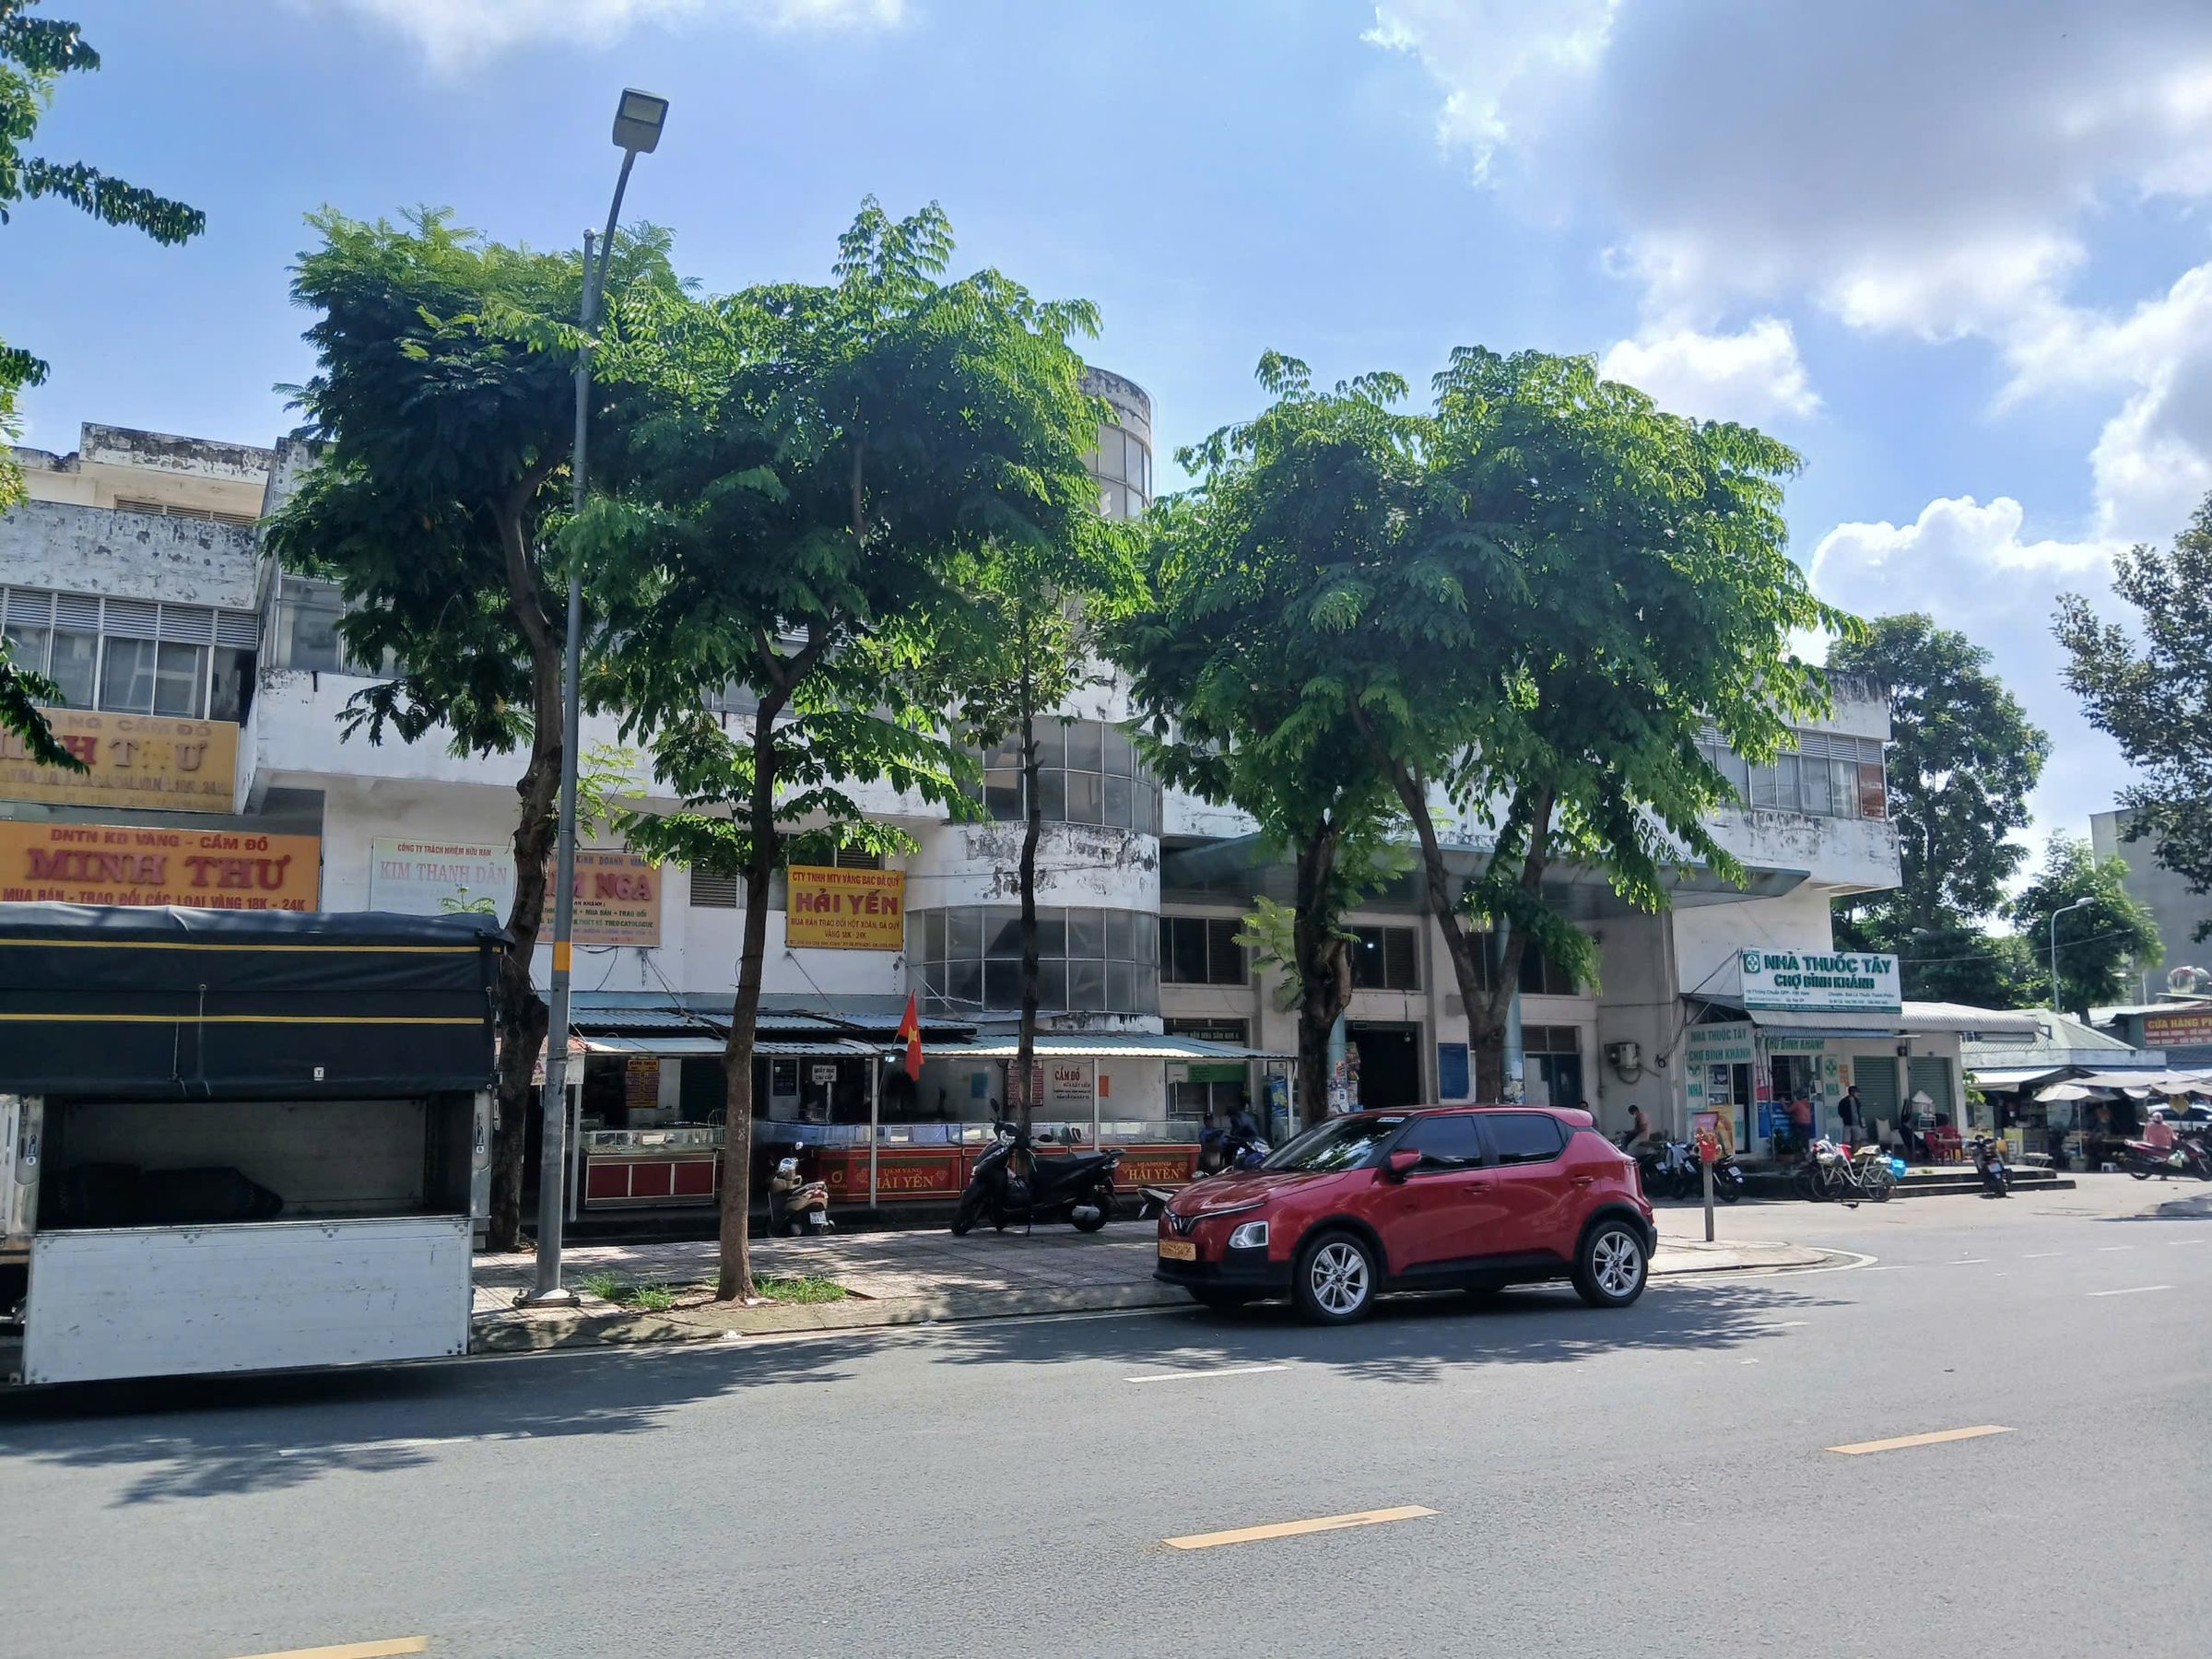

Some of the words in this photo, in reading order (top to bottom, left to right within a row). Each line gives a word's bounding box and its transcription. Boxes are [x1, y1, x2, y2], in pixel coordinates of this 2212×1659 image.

[51, 829, 98, 842] DNTN
[25, 848, 167, 884] MINH
[184, 853, 291, 890] THƯ
[380, 861, 410, 880] KIM
[417, 863, 471, 884] THANH
[475, 862, 508, 885] DÂN
[793, 871, 805, 881] CTY
[807, 872, 826, 882] TNHH
[842, 873, 861, 884] VÀNG
[595, 872, 652, 901] NGA
[795, 888, 841, 913] HẢI
[848, 889, 898, 915] YẾN
[1764, 951, 1800, 971] NHÀ
[1802, 952, 1859, 973] THUỐC
[1862, 956, 1892, 974] TÂY
[1774, 973, 1801, 990] CHỢ
[1804, 972, 1832, 988] BÌNH
[1833, 973, 1875, 989] KHÁNH
[2171, 1017, 2198, 1028] HÀNG
[1054, 1066, 1070, 1081] CẦM
[1071, 1067, 1080, 1081] ĐỒ
